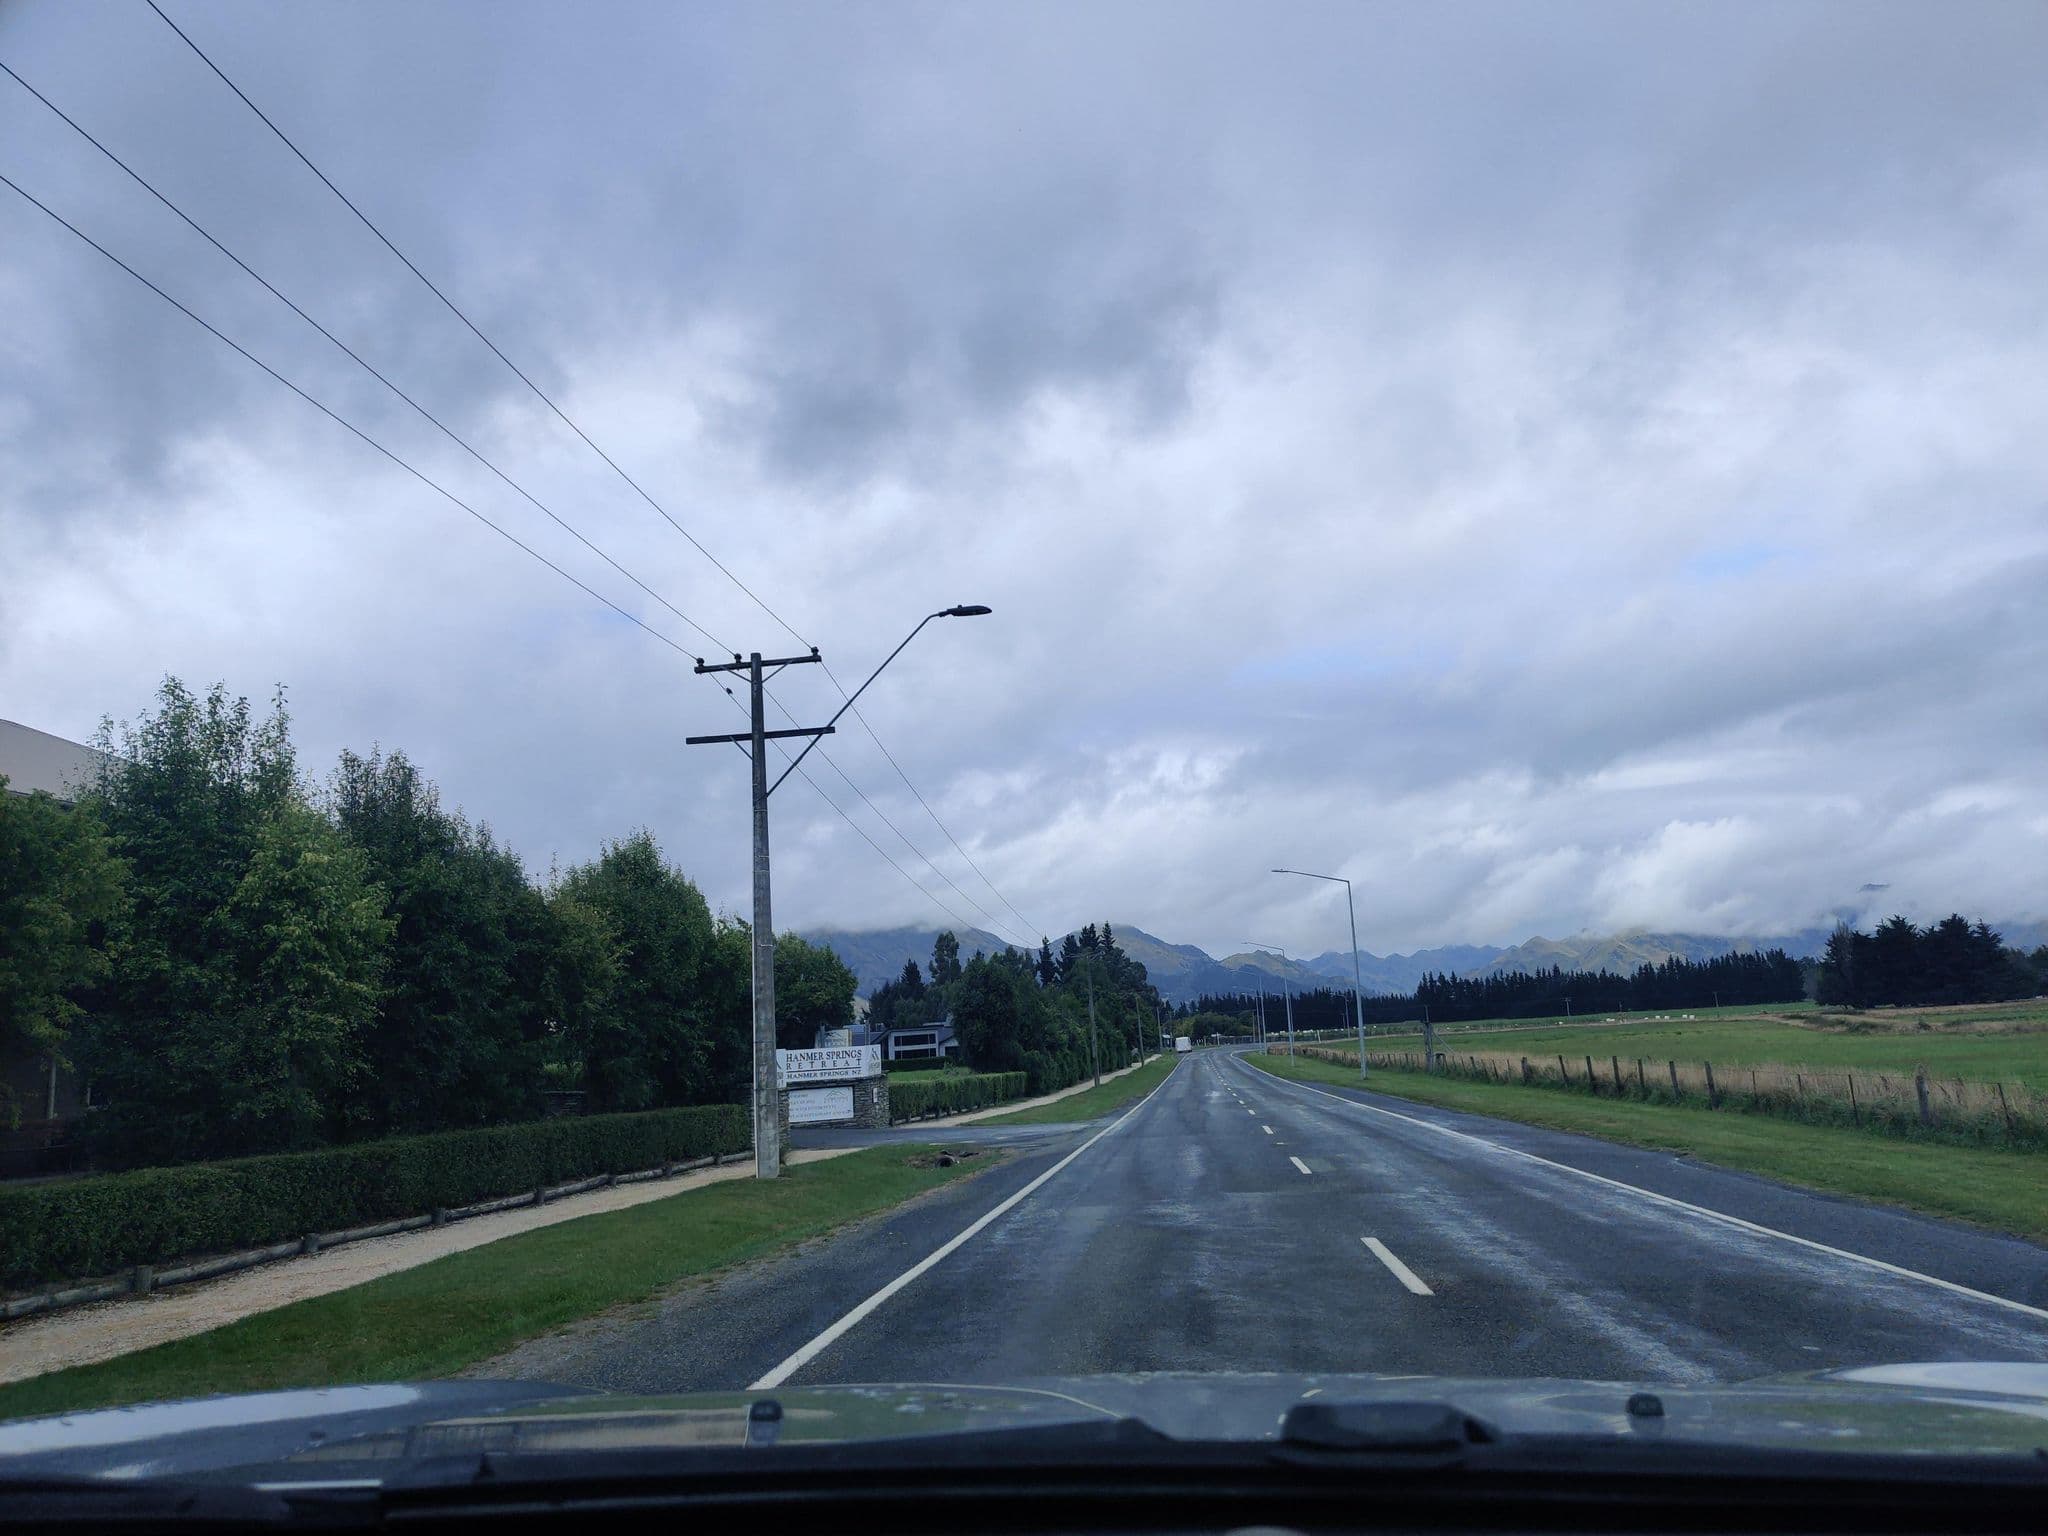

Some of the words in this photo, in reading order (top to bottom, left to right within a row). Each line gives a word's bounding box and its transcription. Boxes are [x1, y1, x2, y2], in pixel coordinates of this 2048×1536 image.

[786, 1052, 824, 1062] HANMER
[826, 1049, 862, 1060] SPRINGS
[786, 1059, 862, 1070] RETREAT
